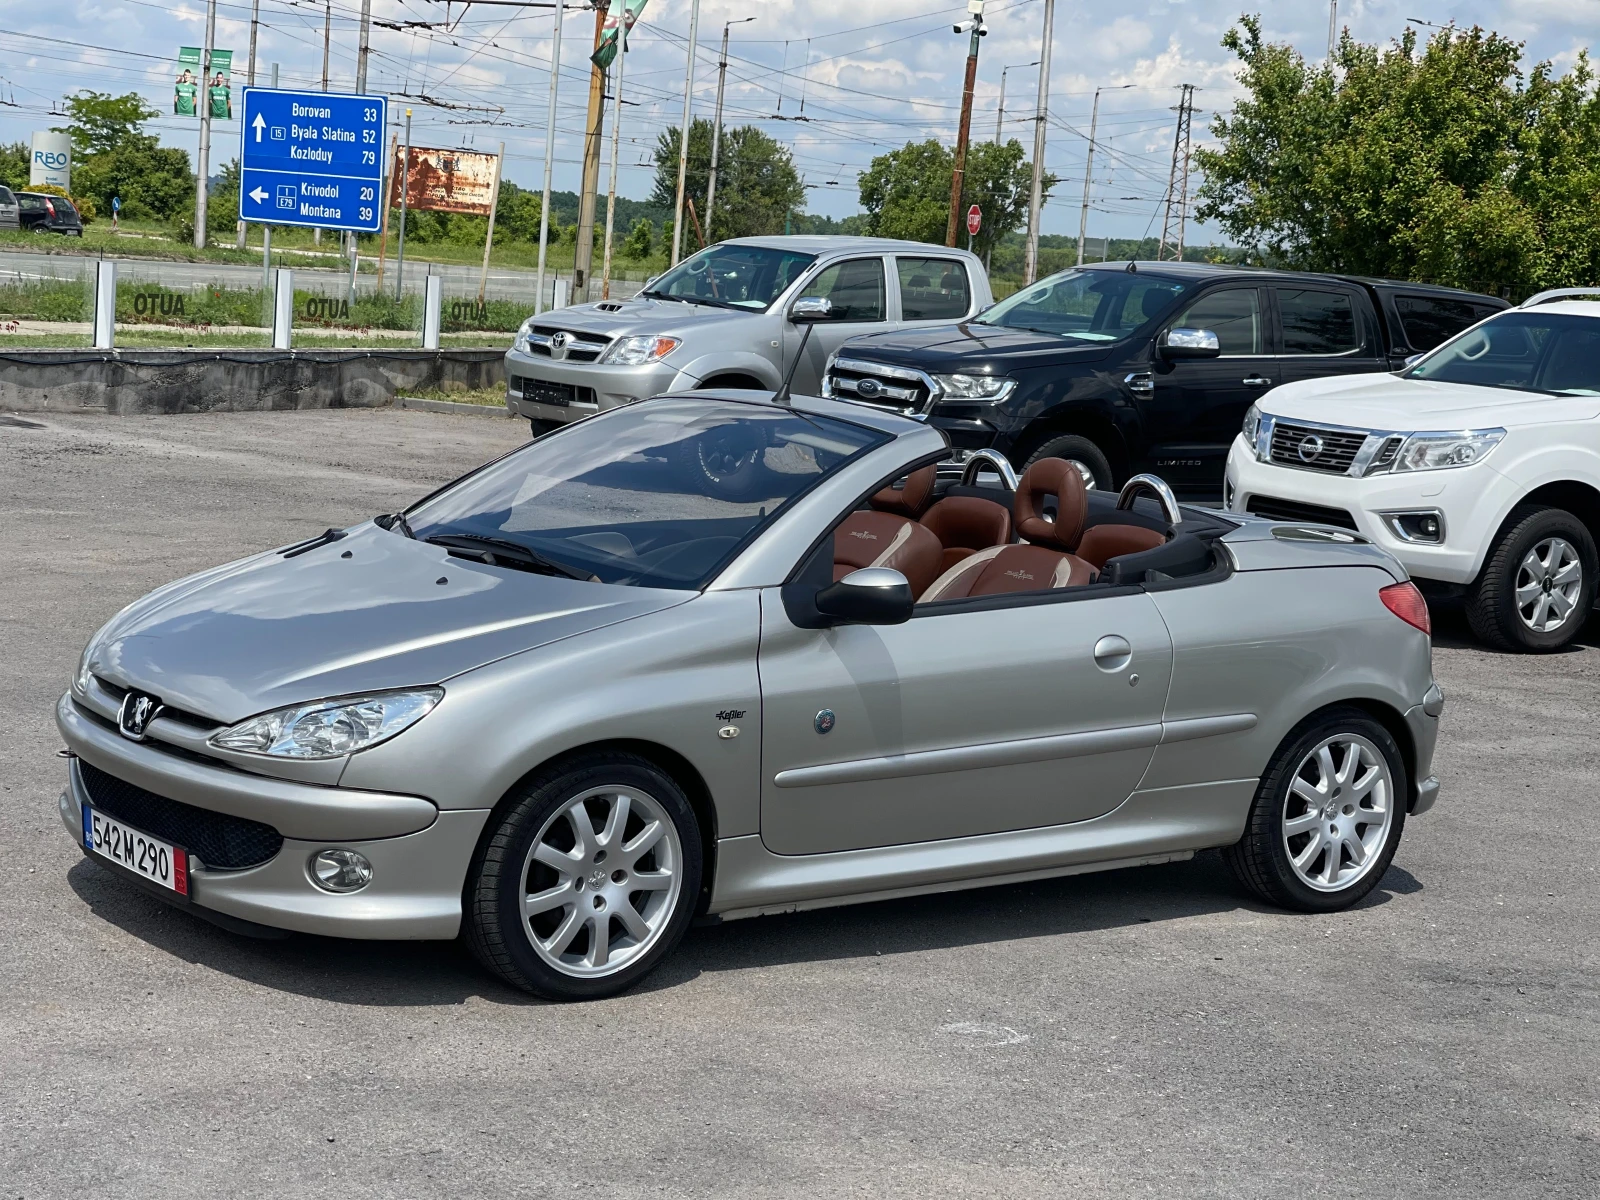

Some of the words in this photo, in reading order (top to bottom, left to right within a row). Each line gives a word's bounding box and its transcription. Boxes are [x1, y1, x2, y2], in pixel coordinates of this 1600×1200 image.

[292, 103, 331, 118] Borovan
[364, 108, 377, 121] 33
[274, 129, 282, 138] 15
[291, 124, 317, 141] Byala
[322, 127, 356, 142] Slatina
[362, 130, 375, 143] 52
[35, 151, 67, 169] RBO
[290, 145, 333, 164] Kozloduy
[362, 151, 375, 165] 79
[301, 182, 339, 198] Krivodol
[360, 187, 374, 201] 20
[280, 198, 293, 207] E79
[300, 202, 341, 219] Montana
[359, 207, 373, 221] 39
